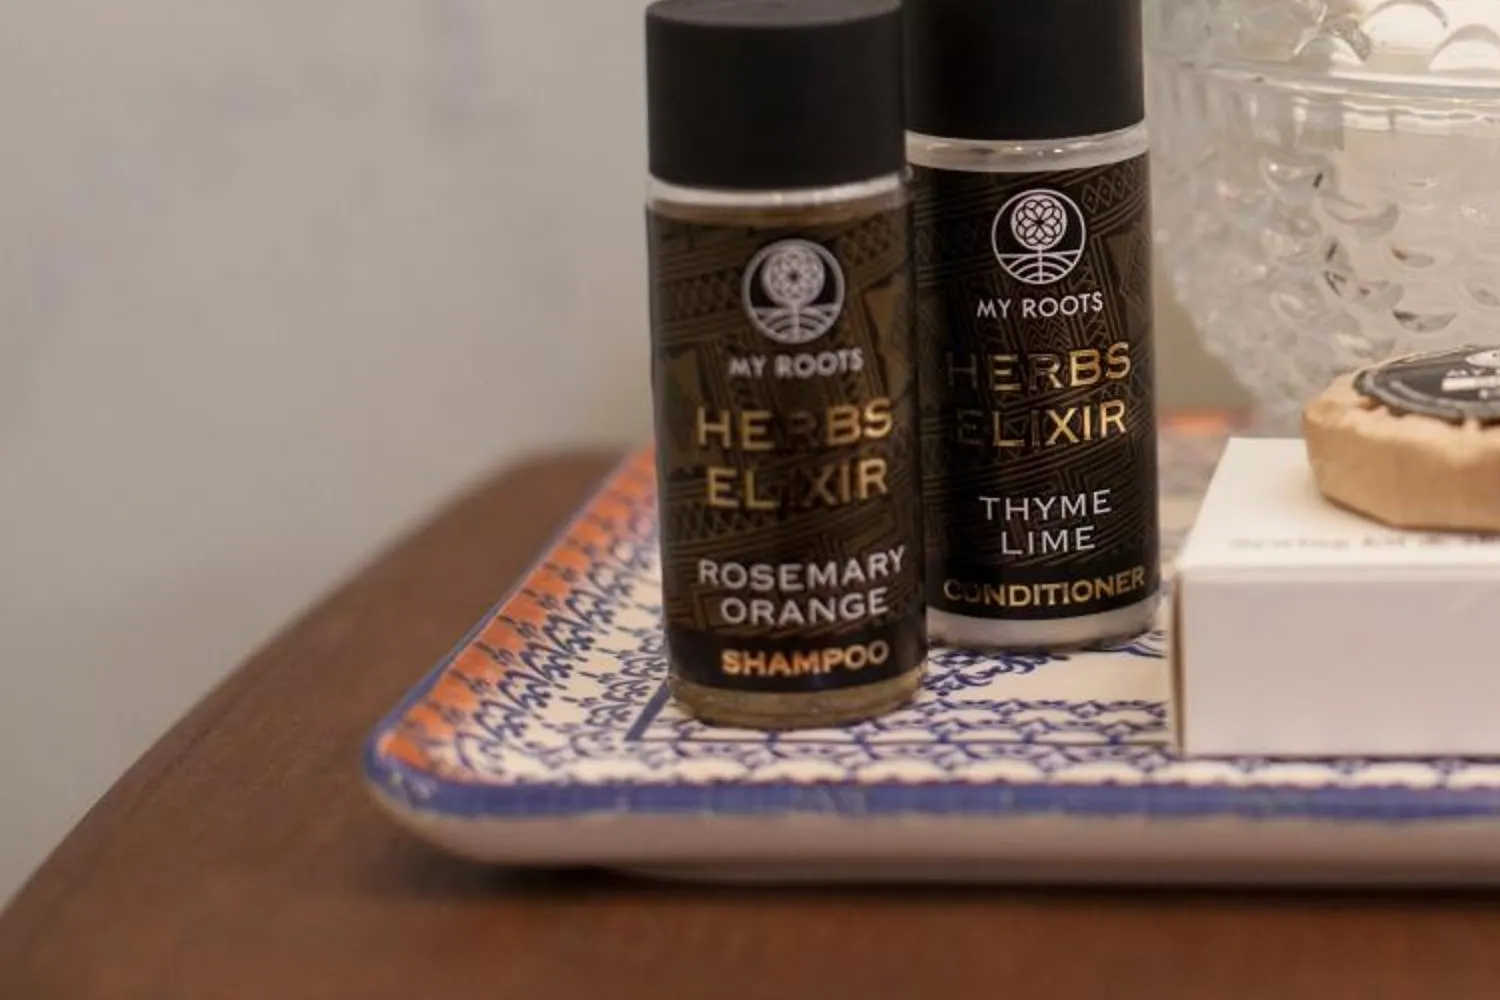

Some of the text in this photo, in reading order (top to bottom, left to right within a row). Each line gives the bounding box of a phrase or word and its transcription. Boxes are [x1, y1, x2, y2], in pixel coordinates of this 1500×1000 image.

[976, 291, 1104, 319] MY ROOTS
[729, 347, 864, 378] MY ROOTS
[946, 341, 1132, 391] HERBS
[697, 397, 893, 451] HERBS
[957, 399, 1128, 447] ELIXIR
[978, 488, 1112, 521] THYME
[1001, 525, 1096, 555] LIME
[698, 545, 906, 592] ROSEMARY
[943, 565, 1146, 608] CONDITIONER
[721, 587, 889, 626] ORANGE
[722, 640, 889, 675] SHAMPOO
